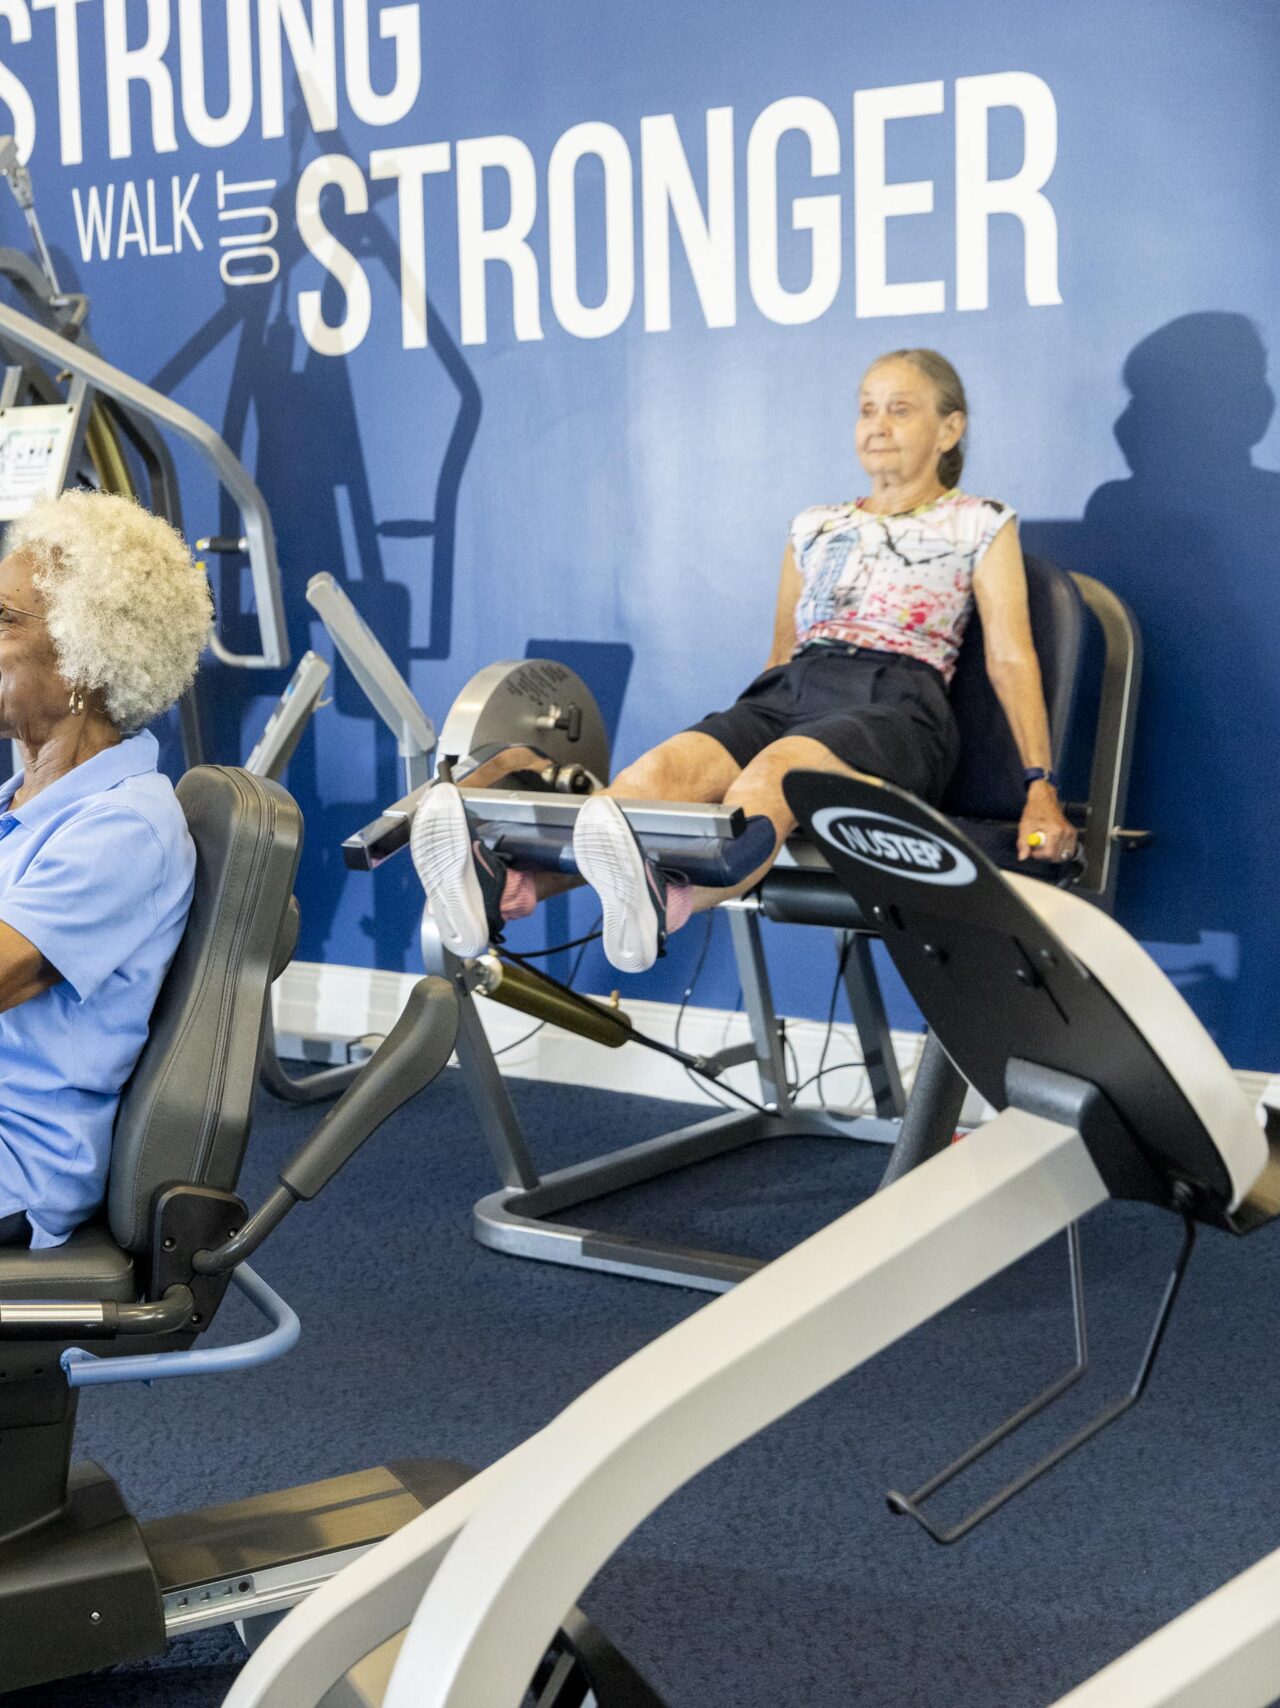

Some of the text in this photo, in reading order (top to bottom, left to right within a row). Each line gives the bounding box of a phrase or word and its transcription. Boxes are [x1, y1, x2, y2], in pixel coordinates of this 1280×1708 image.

[72, 70, 1063, 355] WALK OUT STRONGER
